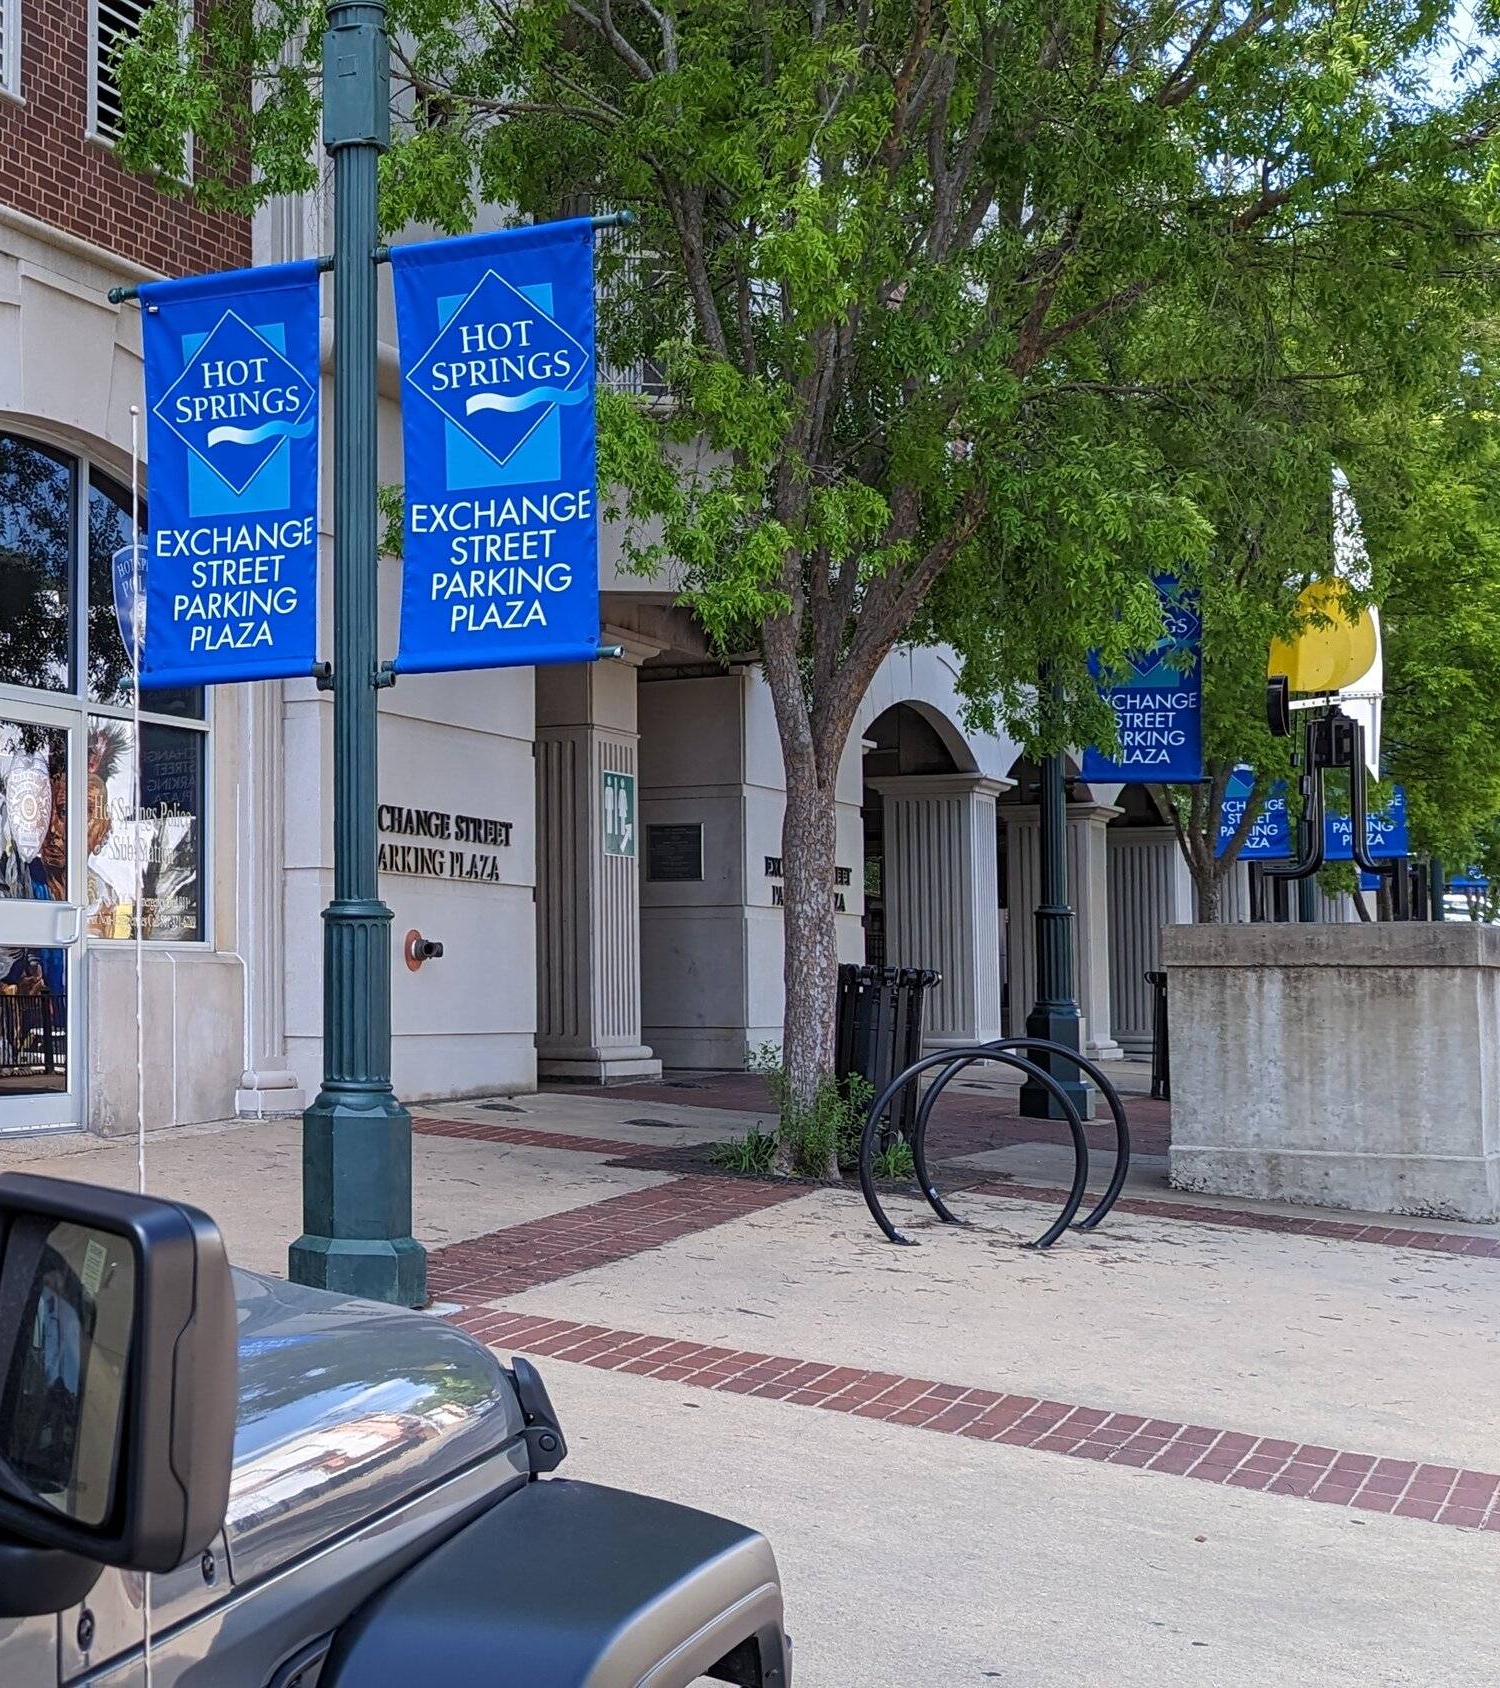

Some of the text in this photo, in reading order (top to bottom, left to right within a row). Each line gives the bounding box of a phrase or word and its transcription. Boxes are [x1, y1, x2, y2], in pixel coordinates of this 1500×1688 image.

[459, 320, 534, 354] HOT
[201, 357, 268, 389] HOT
[432, 350, 571, 391] SPRINGS
[176, 385, 300, 423] SPRINGS
[412, 489, 591, 533] EXCHANGE
[156, 516, 314, 557] EXCHANGE
[450, 529, 557, 566] STREET
[191, 555, 285, 588] STREET
[431, 563, 573, 601] PARKING
[174, 587, 297, 621] PARKING
[451, 599, 547, 632] PLAZA
[190, 620, 273, 651] PLAZA
[1101, 692, 1197, 710] XCHANGE
[1114, 712, 1176, 728] STREET
[1116, 730, 1186, 746] RKING
[377, 804, 513, 847] CHANGE STREET
[1220, 824, 1279, 837] PAING
[378, 843, 500, 882] ARKING PLAZA
